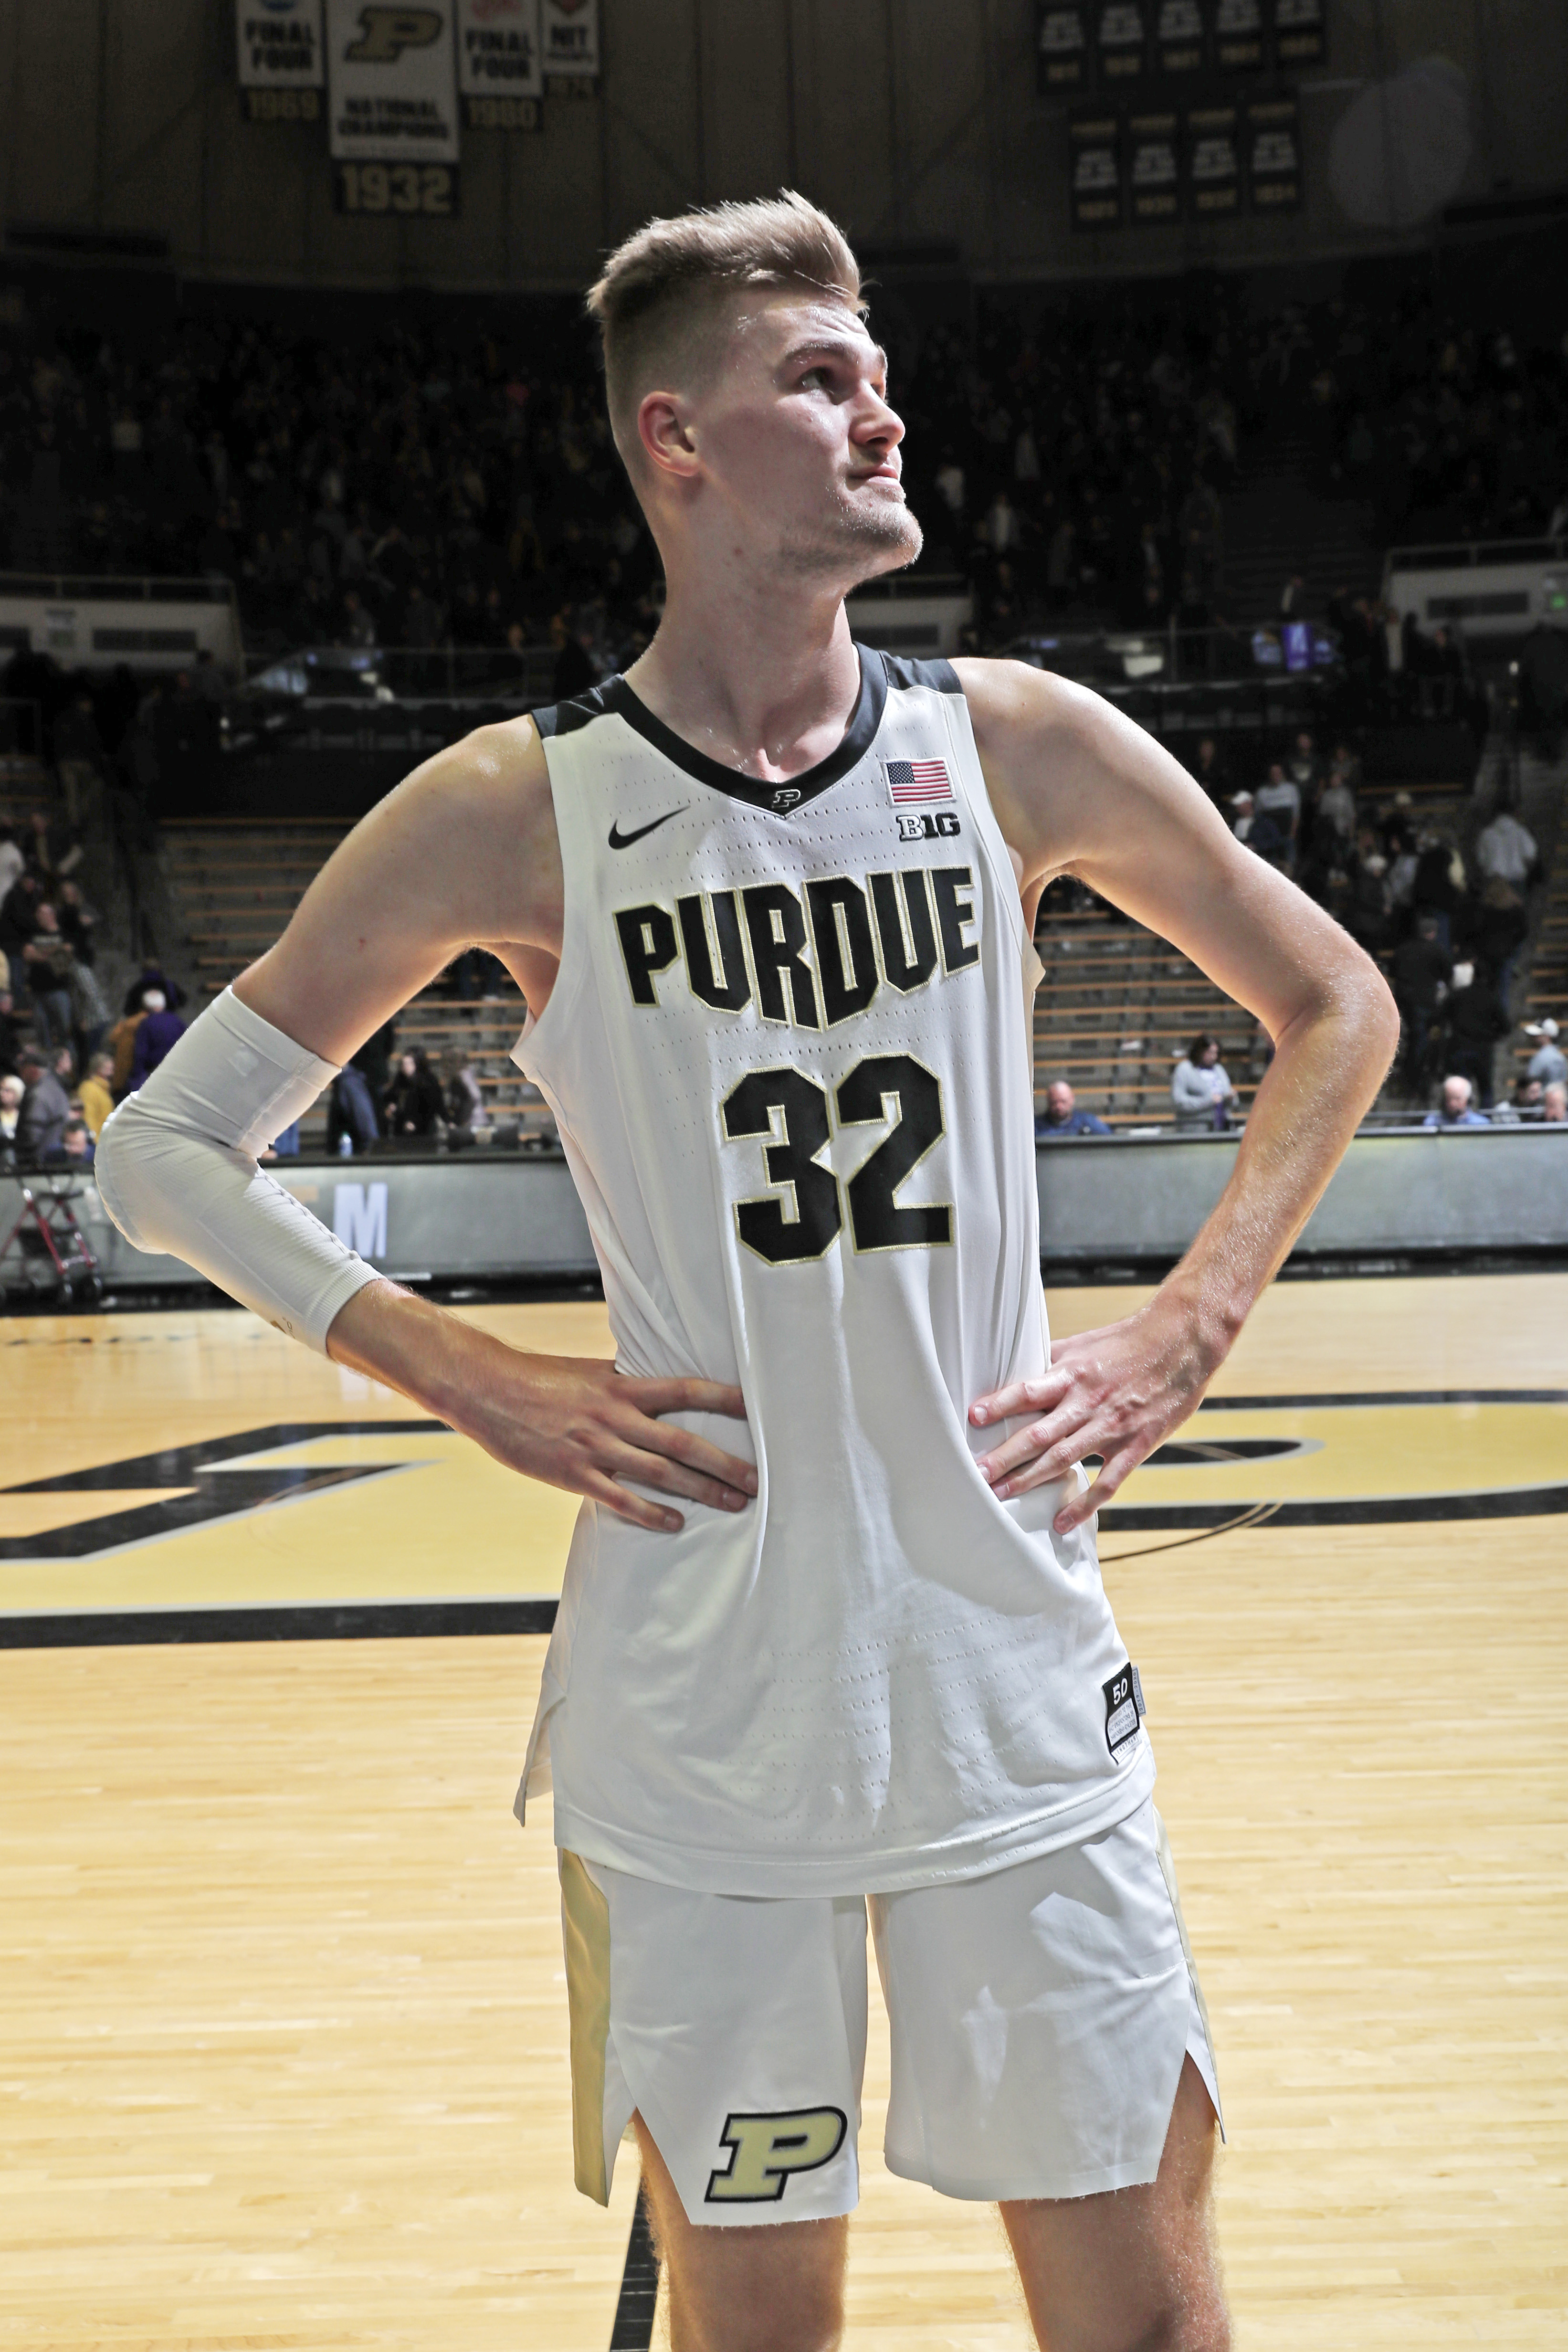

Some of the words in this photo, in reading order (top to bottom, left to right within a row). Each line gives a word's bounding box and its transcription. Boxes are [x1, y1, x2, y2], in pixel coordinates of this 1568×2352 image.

[246, 20, 315, 45] FINAL
[344, 6, 443, 63] P
[465, 29, 532, 56] FINAL
[342, 164, 451, 212] 1932
[771, 789, 801, 809] P
[612, 865, 981, 1033] PURDUE
[719, 1051, 955, 1267] 32
[1113, 1677, 1128, 1705] 50
[704, 2106, 848, 2203] P
